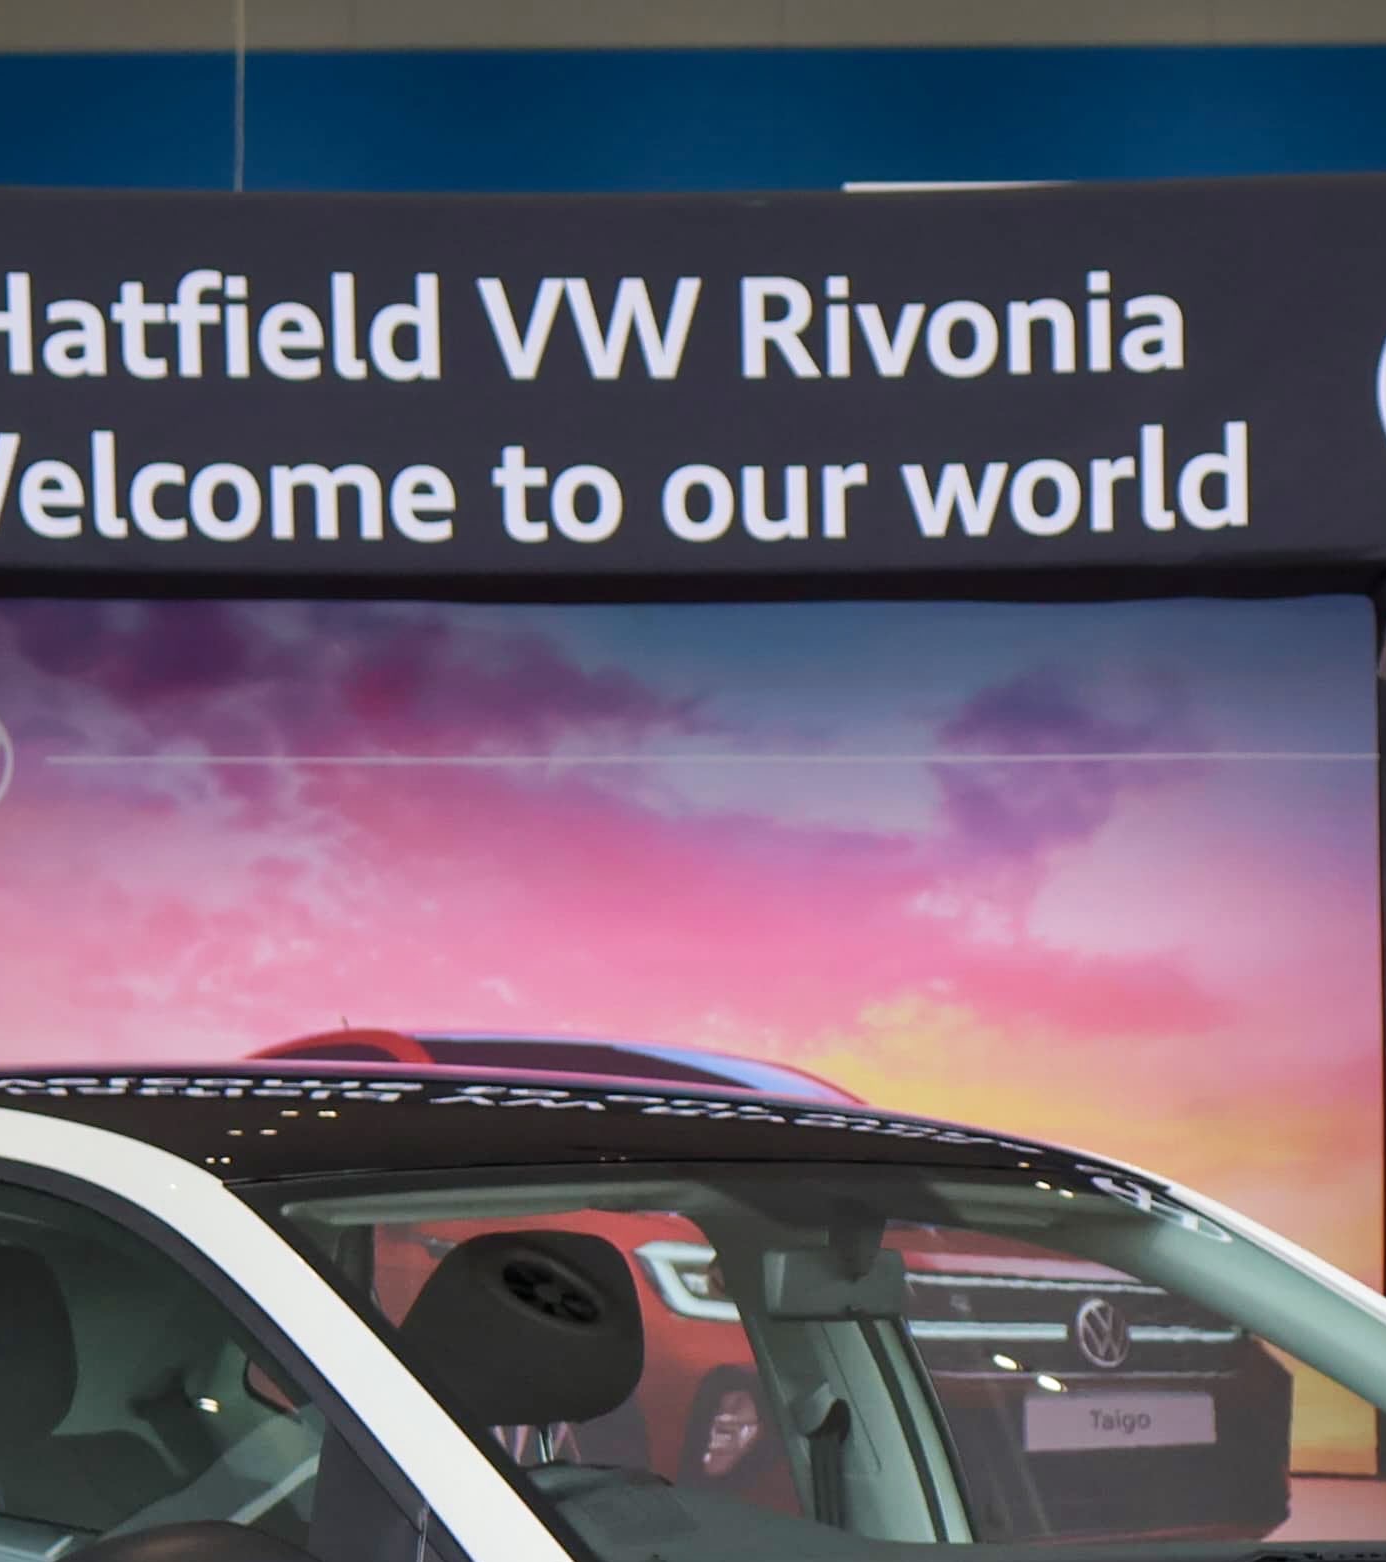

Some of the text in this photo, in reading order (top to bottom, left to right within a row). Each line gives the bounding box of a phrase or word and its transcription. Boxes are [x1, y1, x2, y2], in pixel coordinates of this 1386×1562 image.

[477, 277, 702, 380] VW
[741, 270, 1184, 378] Rivonia
[492, 445, 623, 543] to
[662, 461, 867, 542] our
[901, 420, 1249, 538] world
[1089, 1409, 1151, 1434] Taigo
